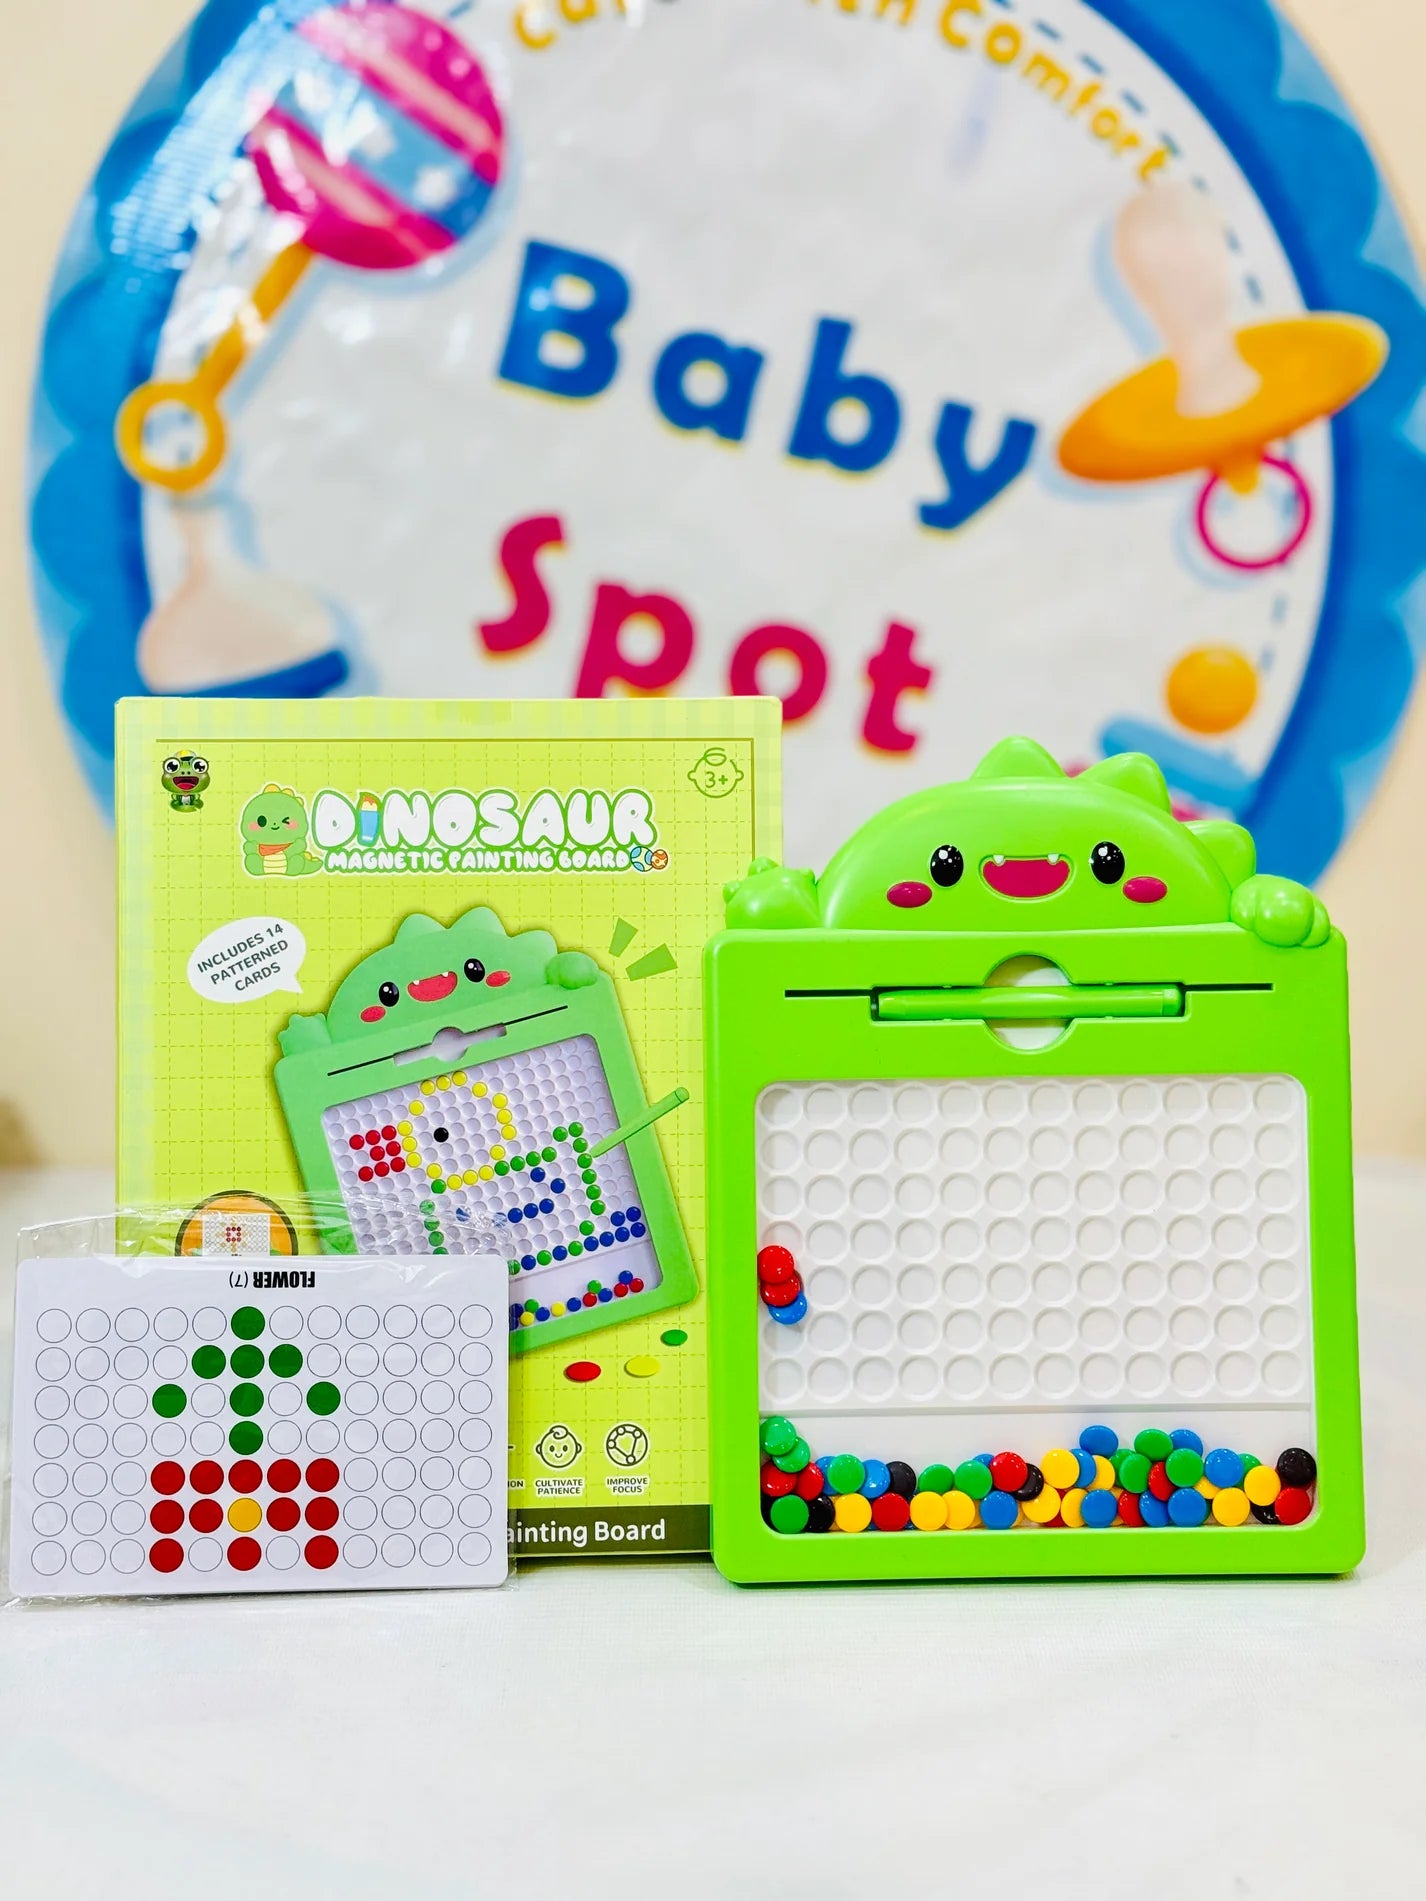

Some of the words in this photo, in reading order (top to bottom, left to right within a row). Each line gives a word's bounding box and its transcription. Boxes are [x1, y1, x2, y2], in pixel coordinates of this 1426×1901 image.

[936, 0, 1172, 184] Comfort
[494, 238, 1038, 532] Baby
[475, 512, 938, 756] Spot
[705, 770, 729, 789] 3+
[312, 789, 658, 848] DINOSAUR
[326, 848, 443, 871] MAGNETIC
[448, 847, 553, 871] PAINTING
[558, 847, 629, 869] BOARD
[197, 932, 265, 973] INCLUDES
[266, 923, 284, 938] 14
[210, 939, 289, 985] PATTERNED
[234, 961, 281, 991] CARDS
[229, 1271, 249, 1288] (7)
[252, 1271, 315, 1288] FLOWER
[535, 1479, 583, 1487] CULTIVATE
[537, 1487, 581, 1495] PATIENCE
[606, 1477, 648, 1485] IMPROVE
[507, 1520, 588, 1548] ainting
[594, 1518, 666, 1542] Board
